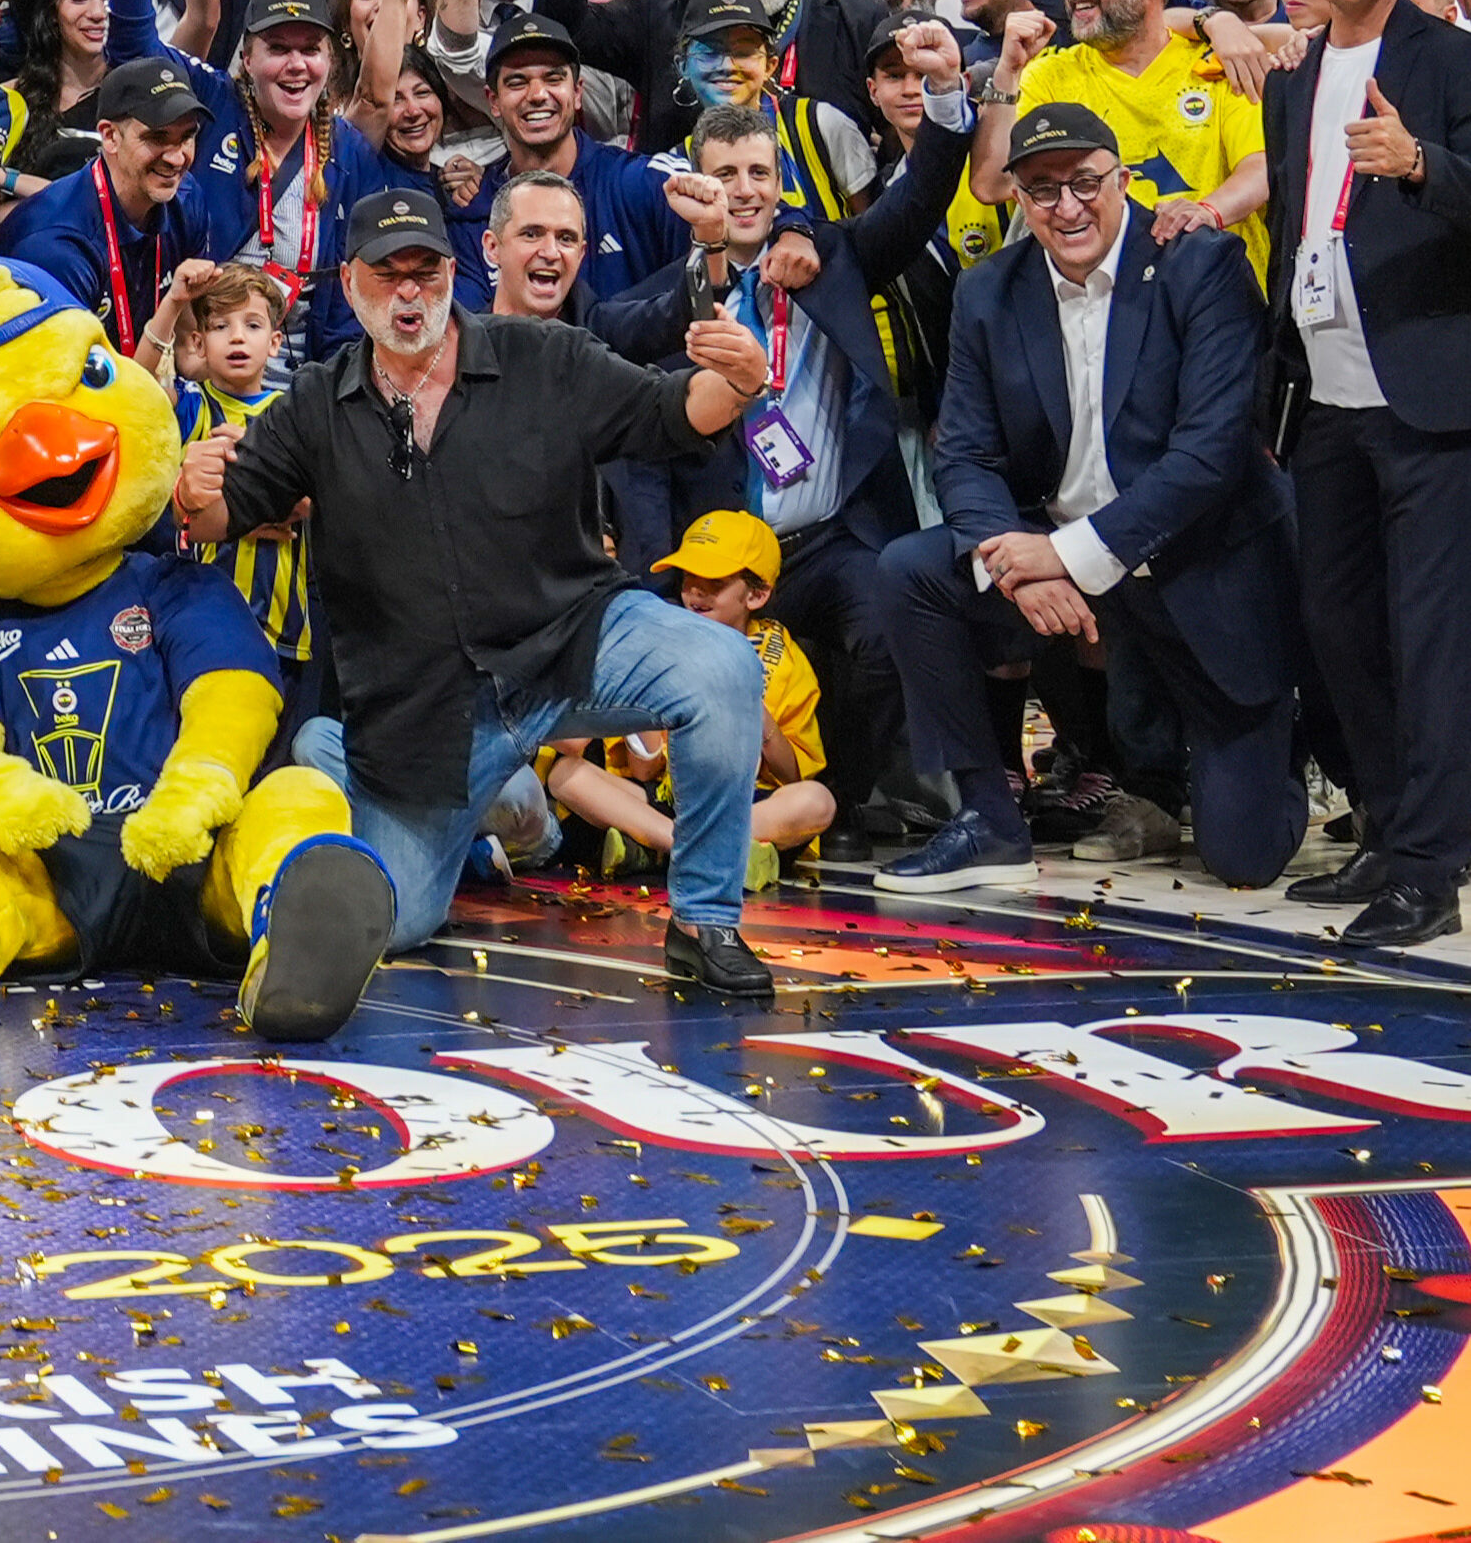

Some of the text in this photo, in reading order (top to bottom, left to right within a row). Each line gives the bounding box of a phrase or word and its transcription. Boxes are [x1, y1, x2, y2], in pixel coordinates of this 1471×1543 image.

[378, 215, 429, 228] CHAMPIONS
[53, 713, 79, 725] beko
[37, 1216, 743, 1301] 2025
